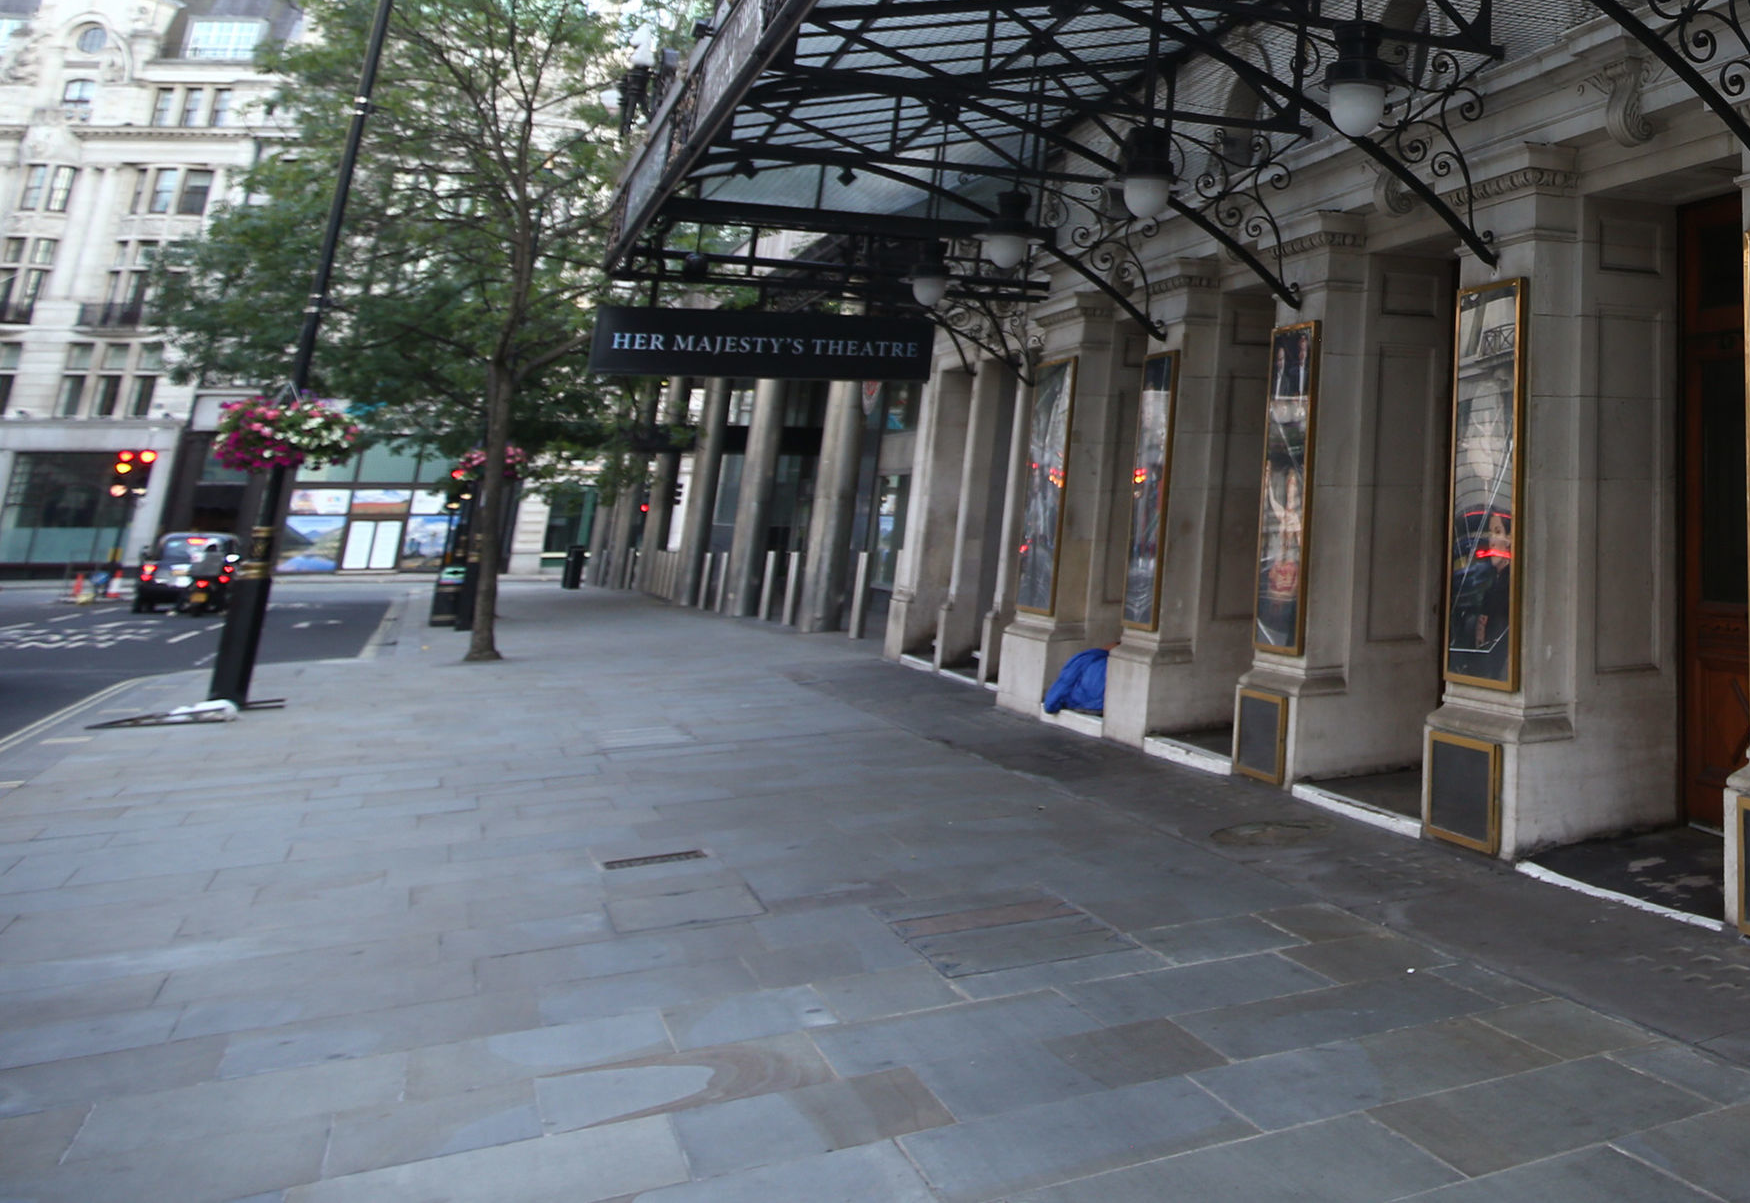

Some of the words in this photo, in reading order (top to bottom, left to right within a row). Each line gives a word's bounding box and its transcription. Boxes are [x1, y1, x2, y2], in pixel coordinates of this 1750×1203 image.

[612, 332, 665, 351] HER
[672, 335, 804, 355] MAJESTY’S
[811, 339, 918, 358] THEATRE
